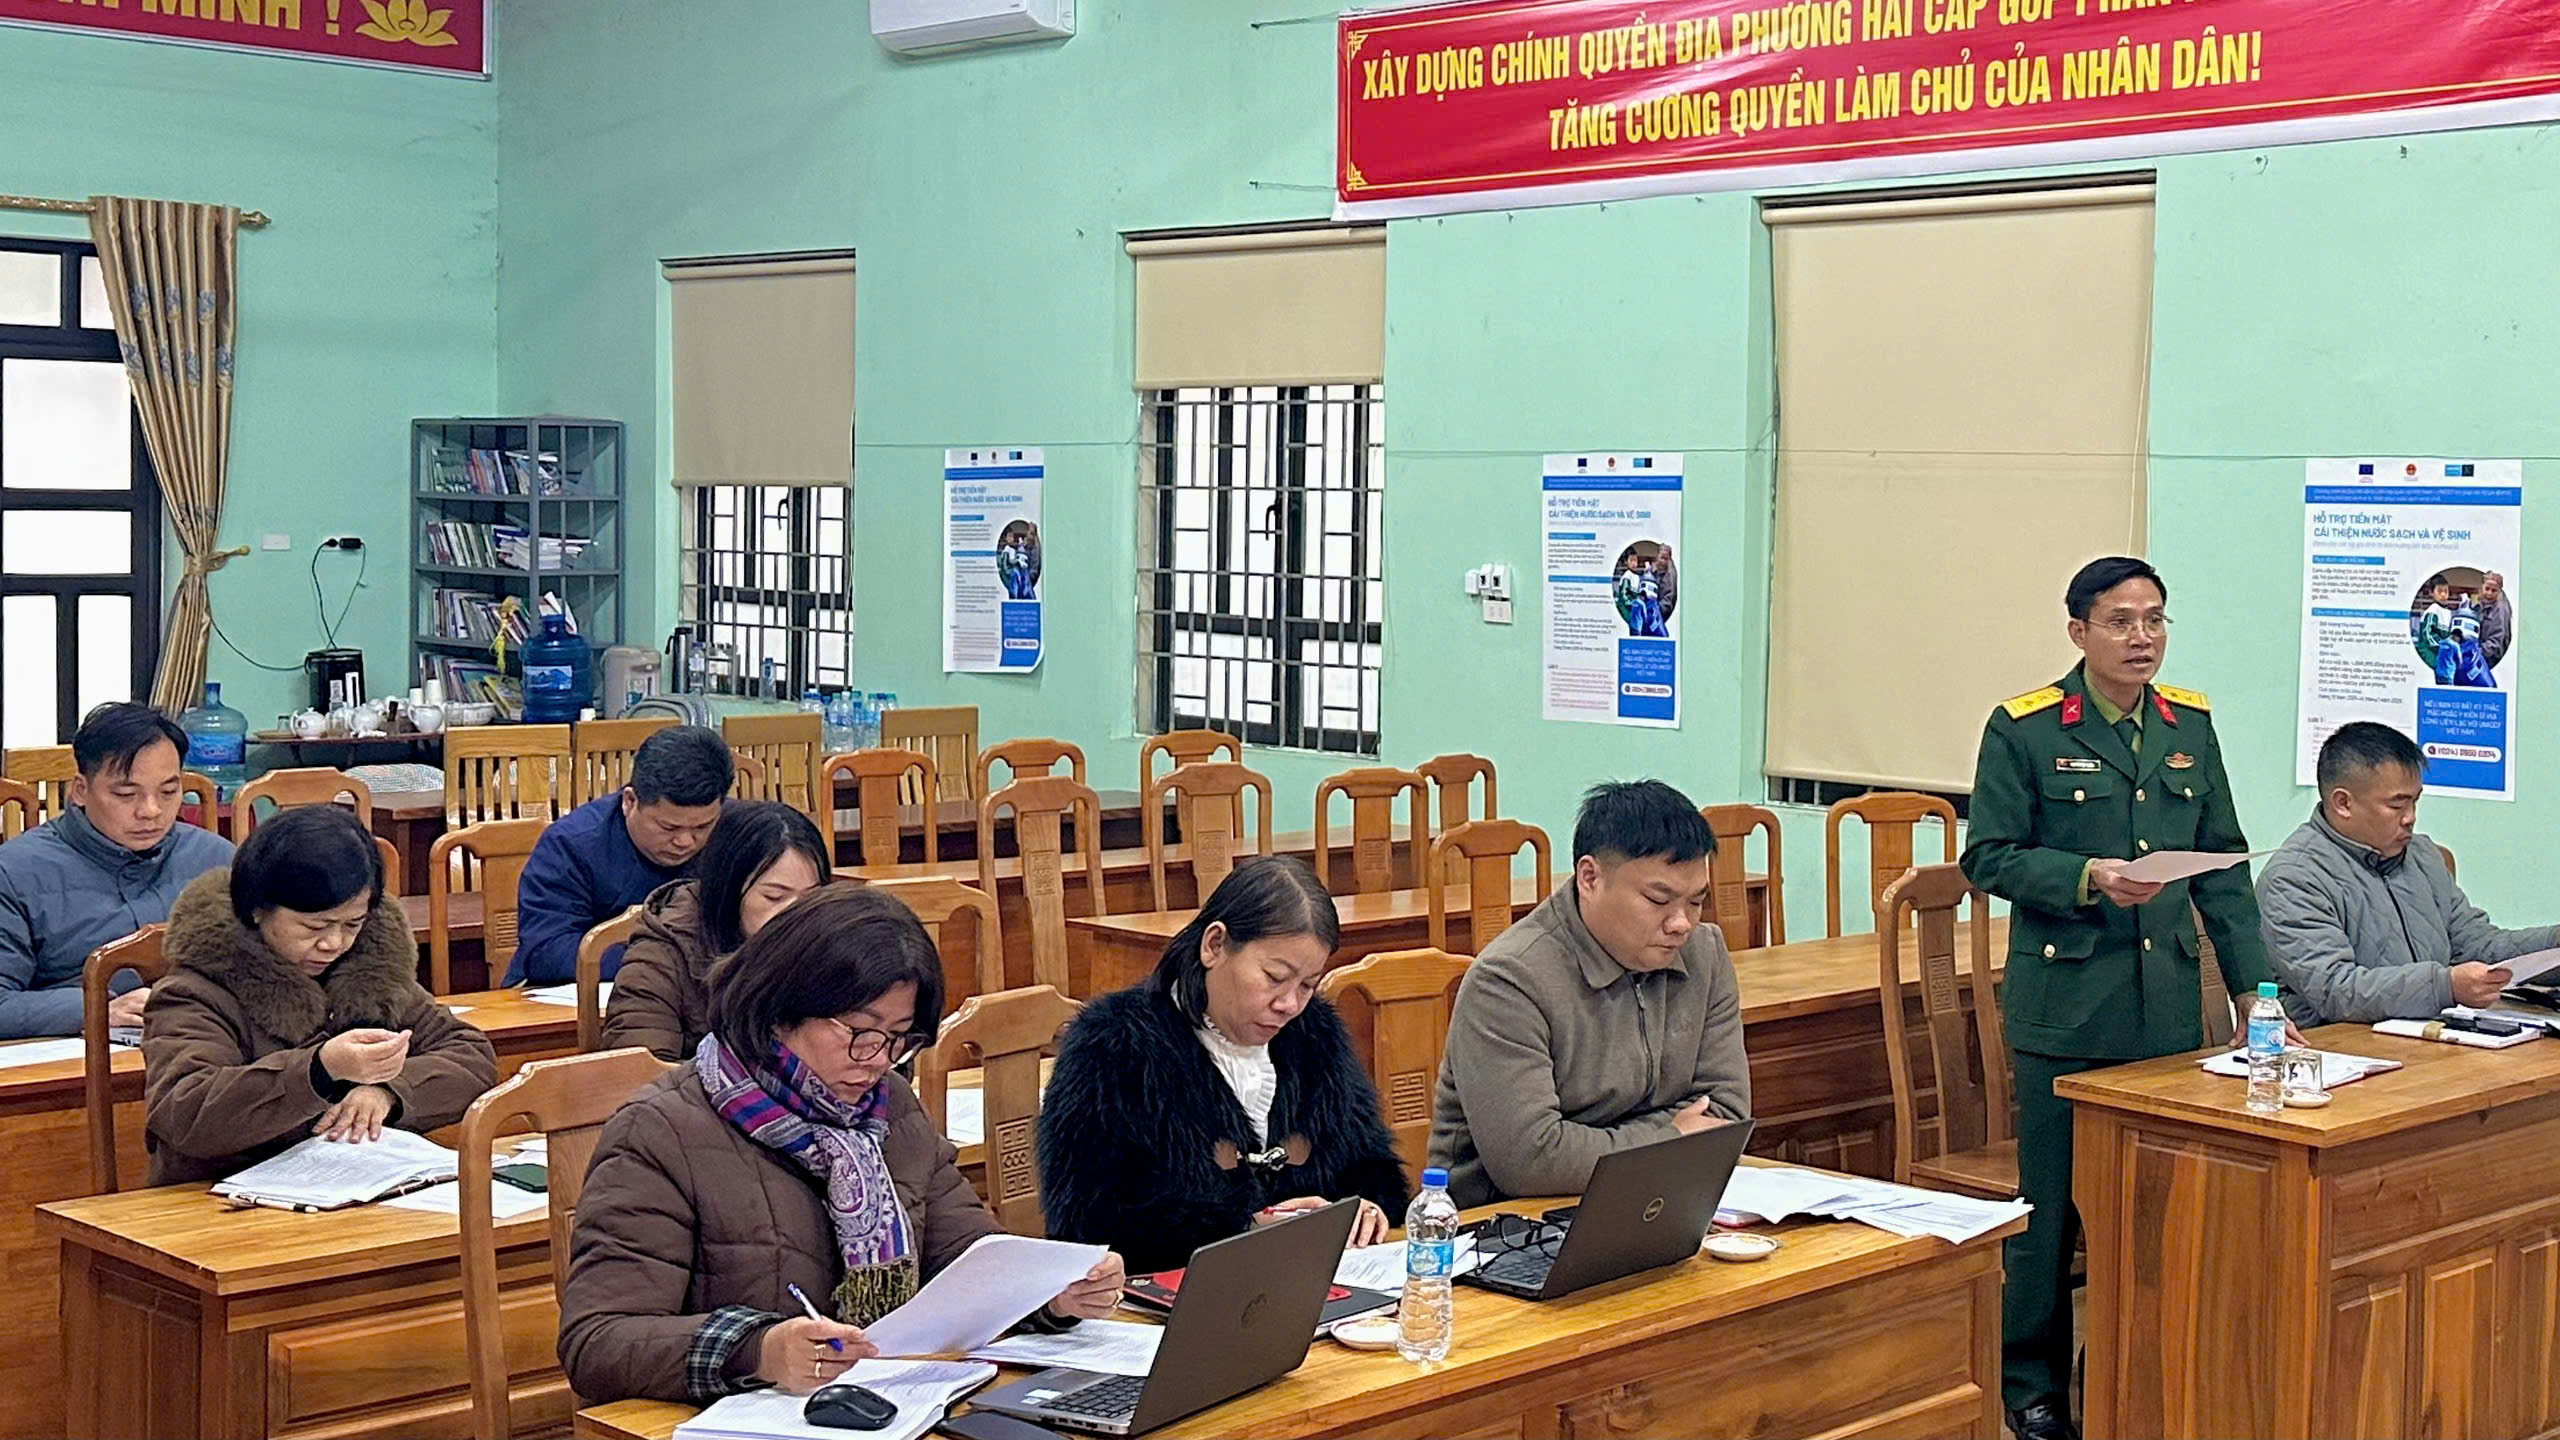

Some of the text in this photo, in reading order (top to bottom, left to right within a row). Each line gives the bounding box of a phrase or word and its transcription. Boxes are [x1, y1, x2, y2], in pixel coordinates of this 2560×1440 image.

[141, 0, 300, 30] NH
[1363, 49, 1409, 100] XÂY
[1416, 46, 1483, 102] DỰNG
[1491, 31, 1570, 86] CHÍNH
[1578, 11, 1667, 80] QUYỀN
[1675, 16, 1723, 72] ĐỊA
[1732, 0, 1852, 57] PHƯƠNG
[1862, 0, 1913, 41] HAI
[1549, 25, 2262, 150] TĂNG CƯỜNG QUYỀN LÀM CHỦ CỦA NHÂN DÂN!
